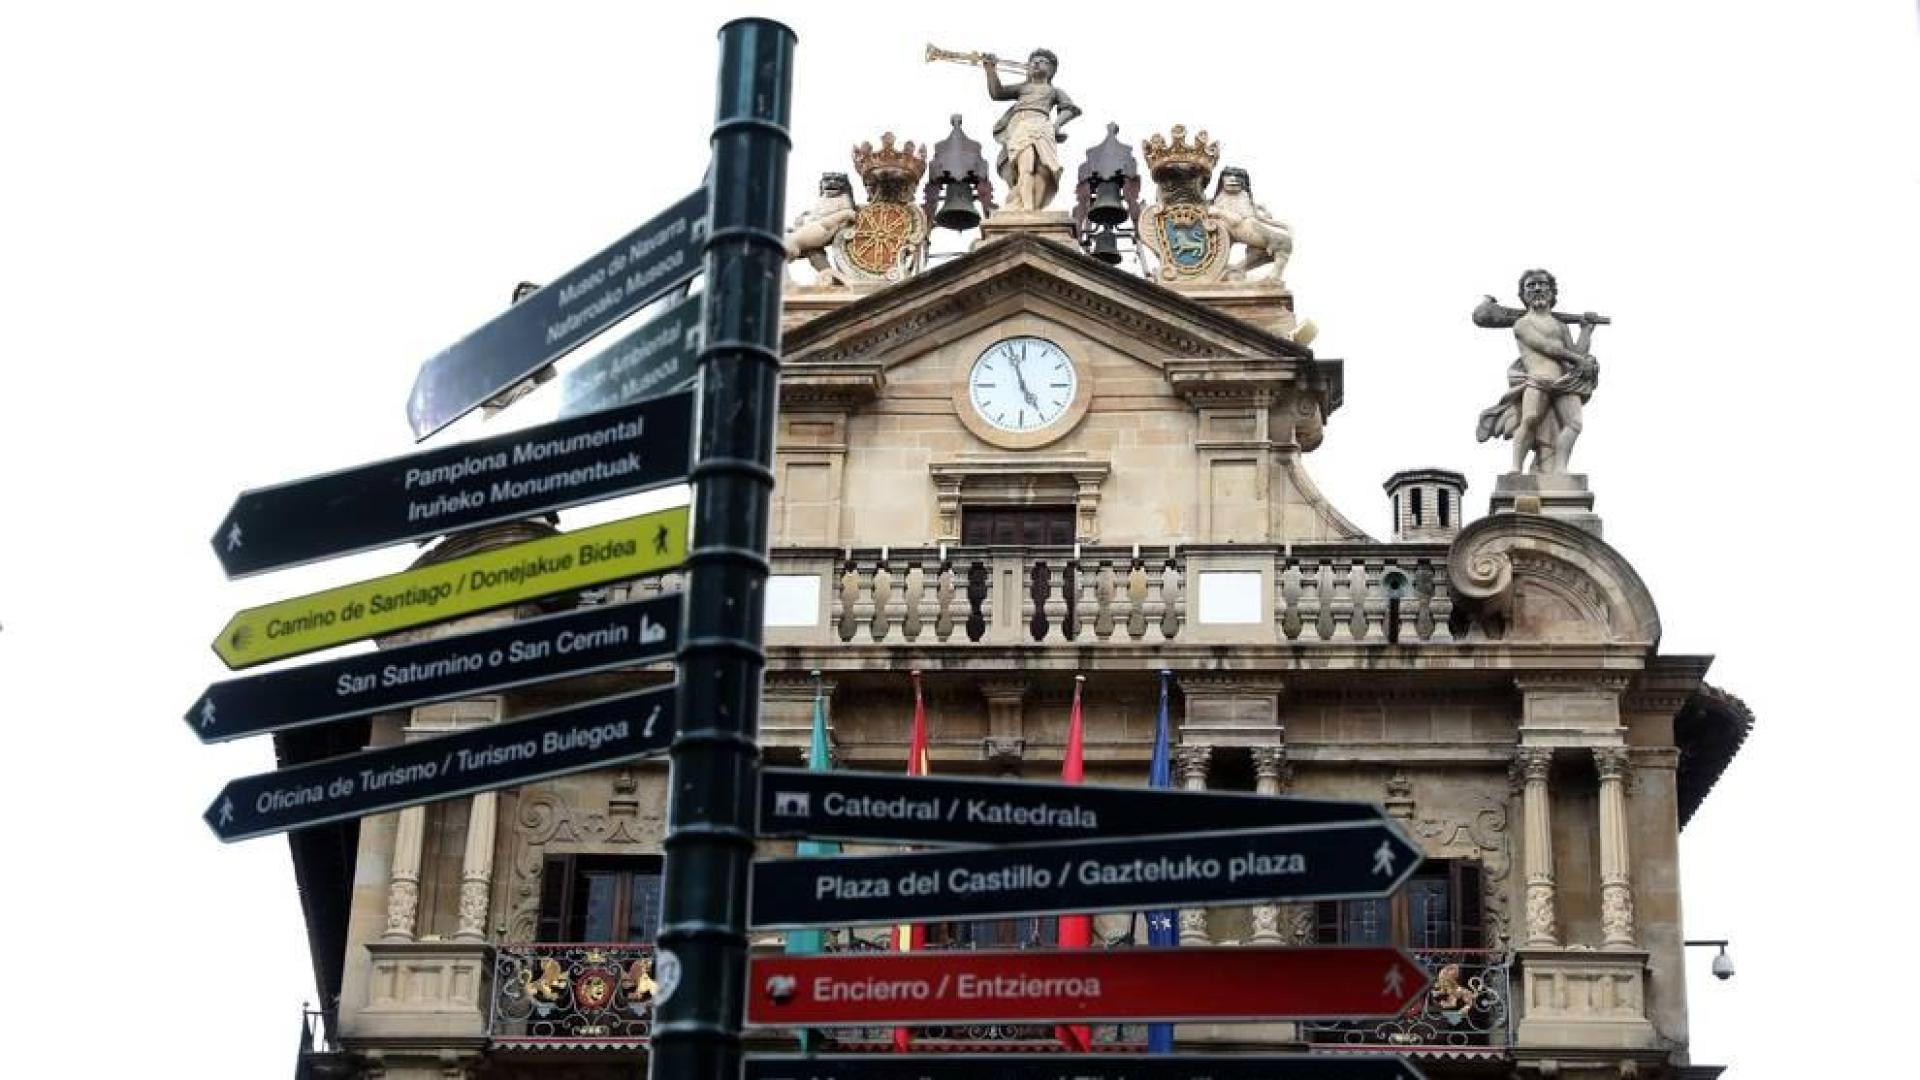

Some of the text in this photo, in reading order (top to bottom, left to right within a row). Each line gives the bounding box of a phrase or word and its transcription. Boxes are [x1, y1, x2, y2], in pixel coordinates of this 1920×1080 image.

[546, 249, 683, 344] Nafarroako Museoa
[559, 217, 687, 308] Museo de Navarra
[405, 415, 644, 489] Pamplona Monumental
[407, 454, 642, 523] Iruñeko Monumentuak
[265, 536, 637, 640] Camino de Santiago / Donejakue Bidea
[336, 624, 629, 696] San Saturnino o San Cernin
[256, 720, 629, 813] Oficina de Turismo / Turismo Bulegoa
[823, 794, 1097, 829] Catedral / Katedrala
[815, 851, 1305, 900] Plaza del Castillo / Gazteluko plaza
[813, 974, 1100, 1002] Encierro / Entzierroa
